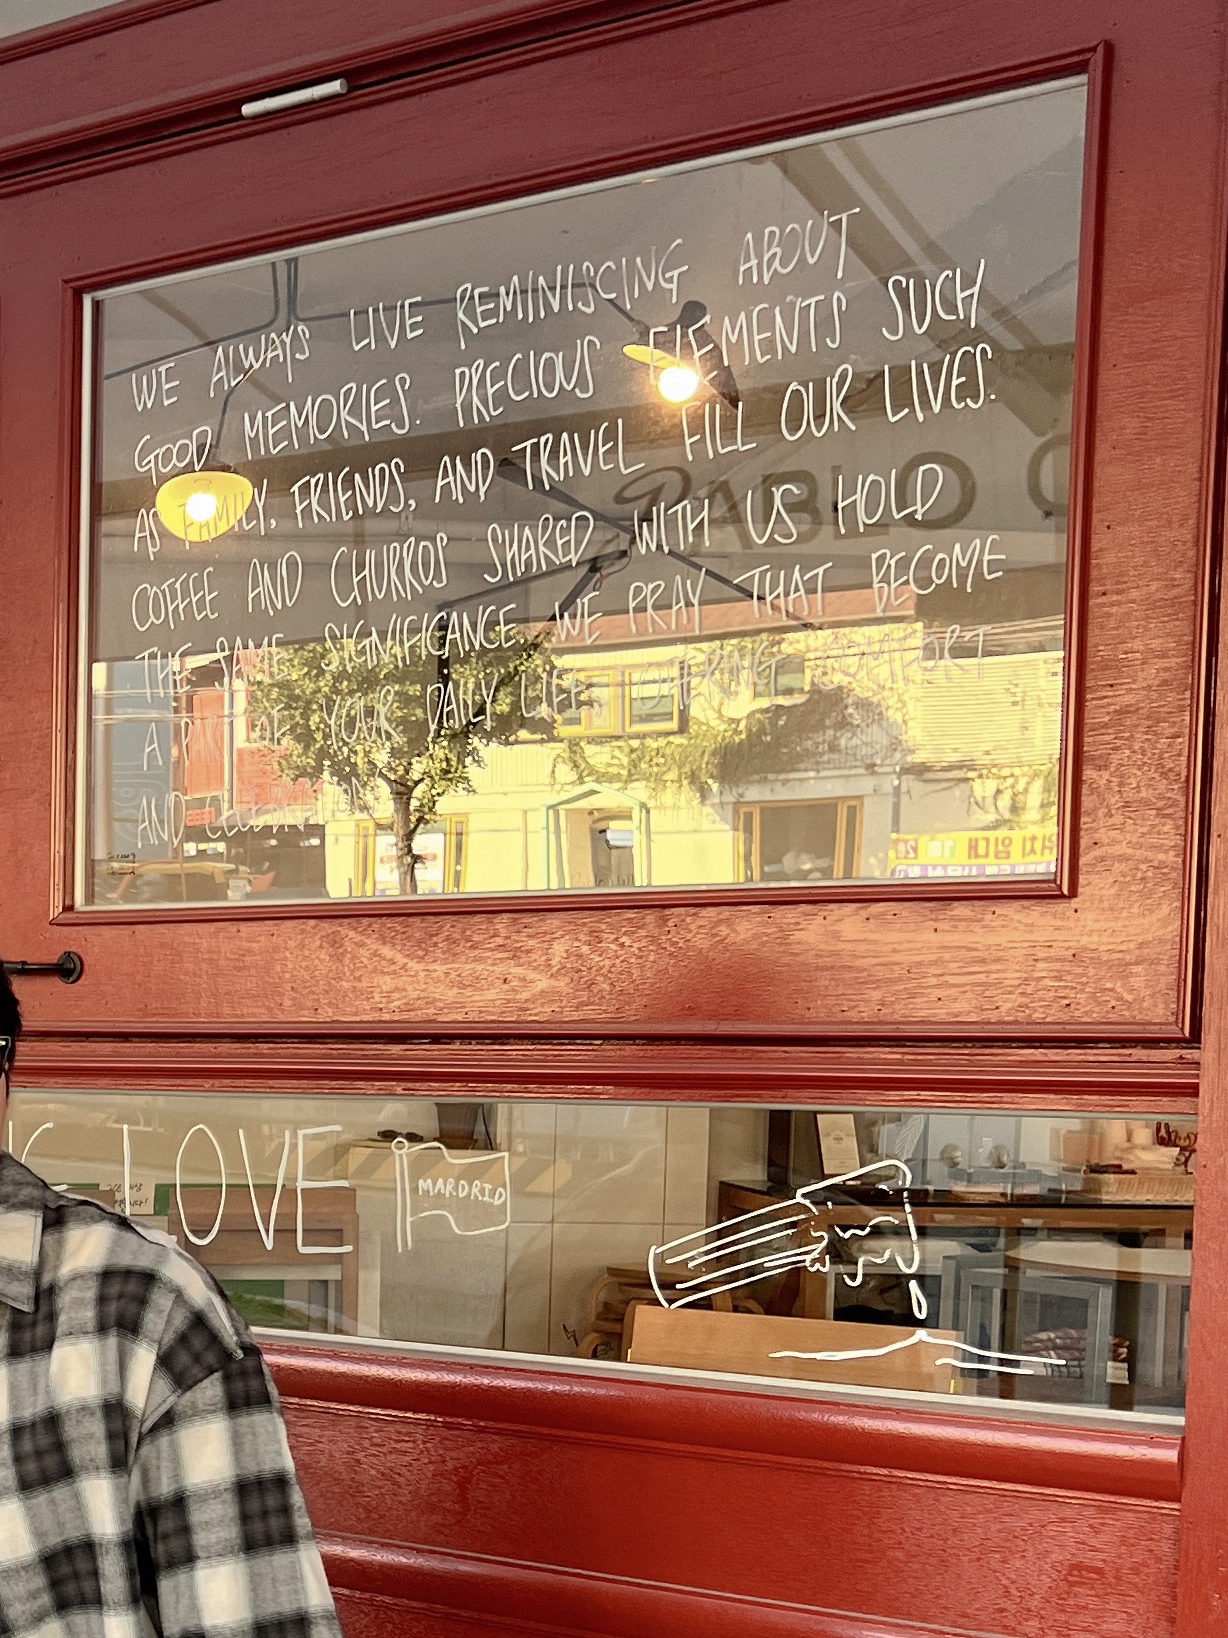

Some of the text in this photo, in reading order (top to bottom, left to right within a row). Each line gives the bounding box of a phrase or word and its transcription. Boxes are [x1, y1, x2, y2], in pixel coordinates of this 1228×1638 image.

[131, 207, 860, 412] WE ALWAYS LIVE REMINISCING ABOUT
[134, 258, 986, 485] GOOD MEMORIES. PRECIOUS ELEMENTS SUCH
[133, 507, 161, 561] AS
[290, 457, 416, 529] FRIENDS,
[434, 447, 494, 504] AND
[511, 417, 645, 491] TRAVEL
[682, 401, 757, 462] FILL
[780, 364, 856, 441] OUR
[884, 343, 996, 423] LIVES.
[132, 463, 945, 632] COFFEE AND CHURROS SHARED WITH US HOLD
[136, 642, 192, 704] THE
[214, 633, 284, 690] SAME
[555, 591, 603, 645] WE
[628, 568, 707, 635] PRAY
[733, 562, 833, 619] THAT
[871, 535, 1007, 616] BECOME
[143, 723, 163, 770] A
[322, 687, 399, 752] YOUR
[427, 672, 498, 738] DAILY
[137, 791, 186, 849] AND
[122, 1122, 353, 1254] LOVE
[417, 1177, 507, 1206] MARDRID
